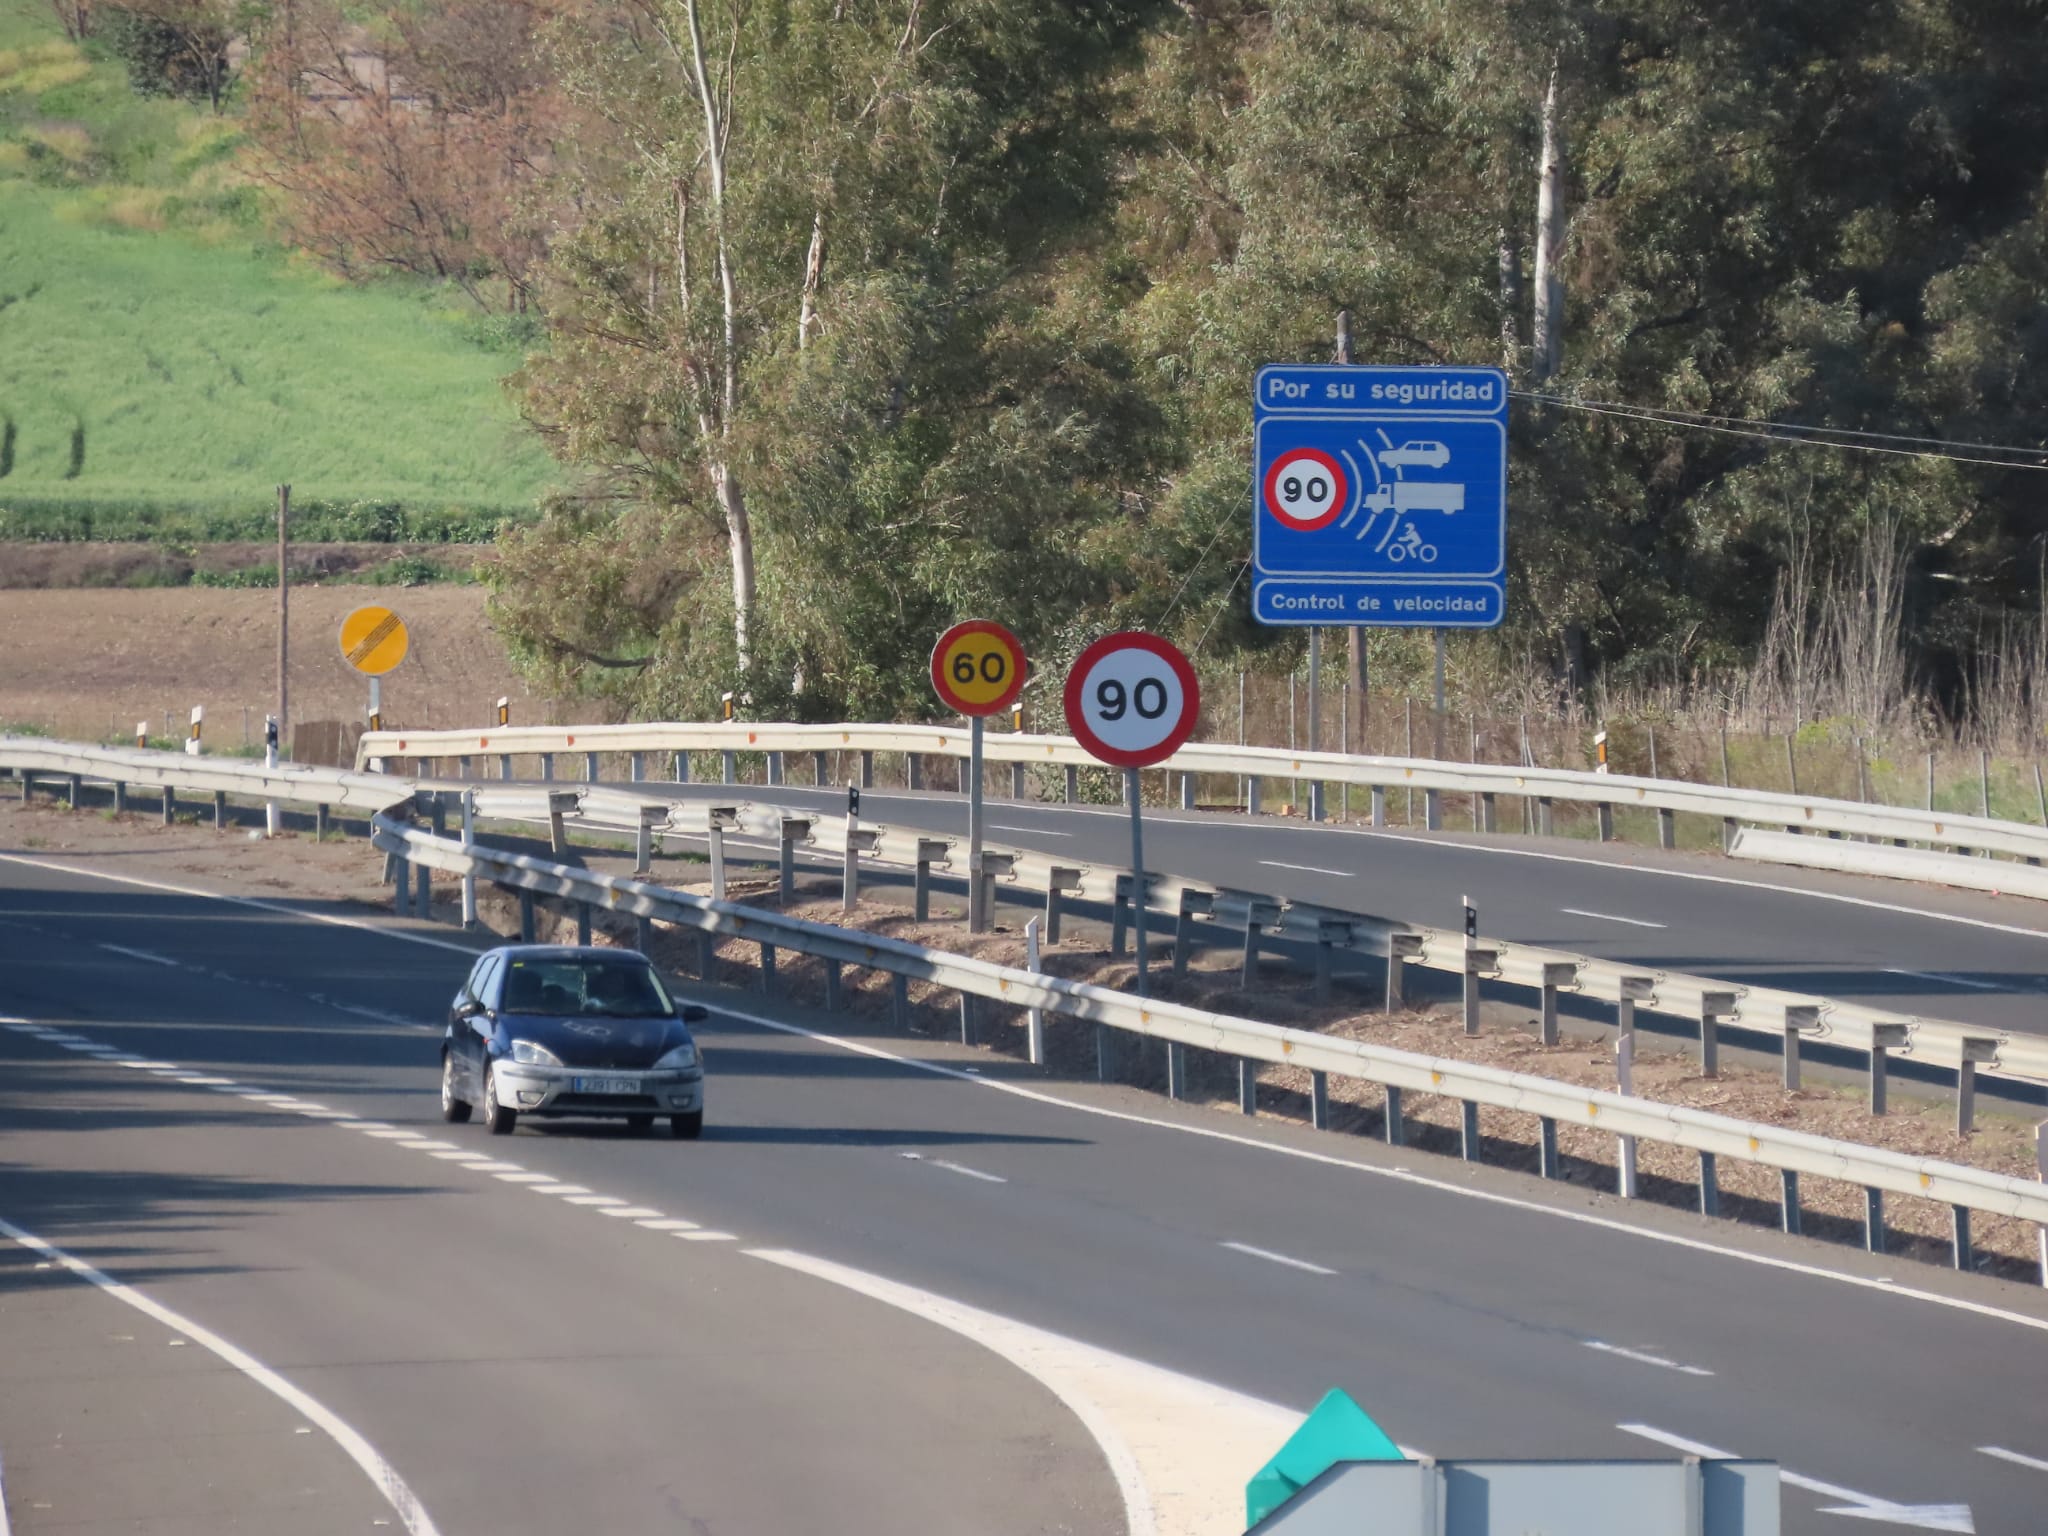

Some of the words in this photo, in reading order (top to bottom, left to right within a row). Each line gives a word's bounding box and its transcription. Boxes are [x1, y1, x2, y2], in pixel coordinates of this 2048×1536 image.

[1269, 378, 1310, 399] Por
[1326, 383, 1355, 399] su
[1371, 379, 1493, 404] seguridad
[1283, 477, 1328, 503] 90
[1271, 594, 1345, 610] Control
[1357, 596, 1380, 611] de
[1394, 596, 1487, 612] velocidad
[953, 652, 1005, 684] 60
[1096, 677, 1168, 722] 90
